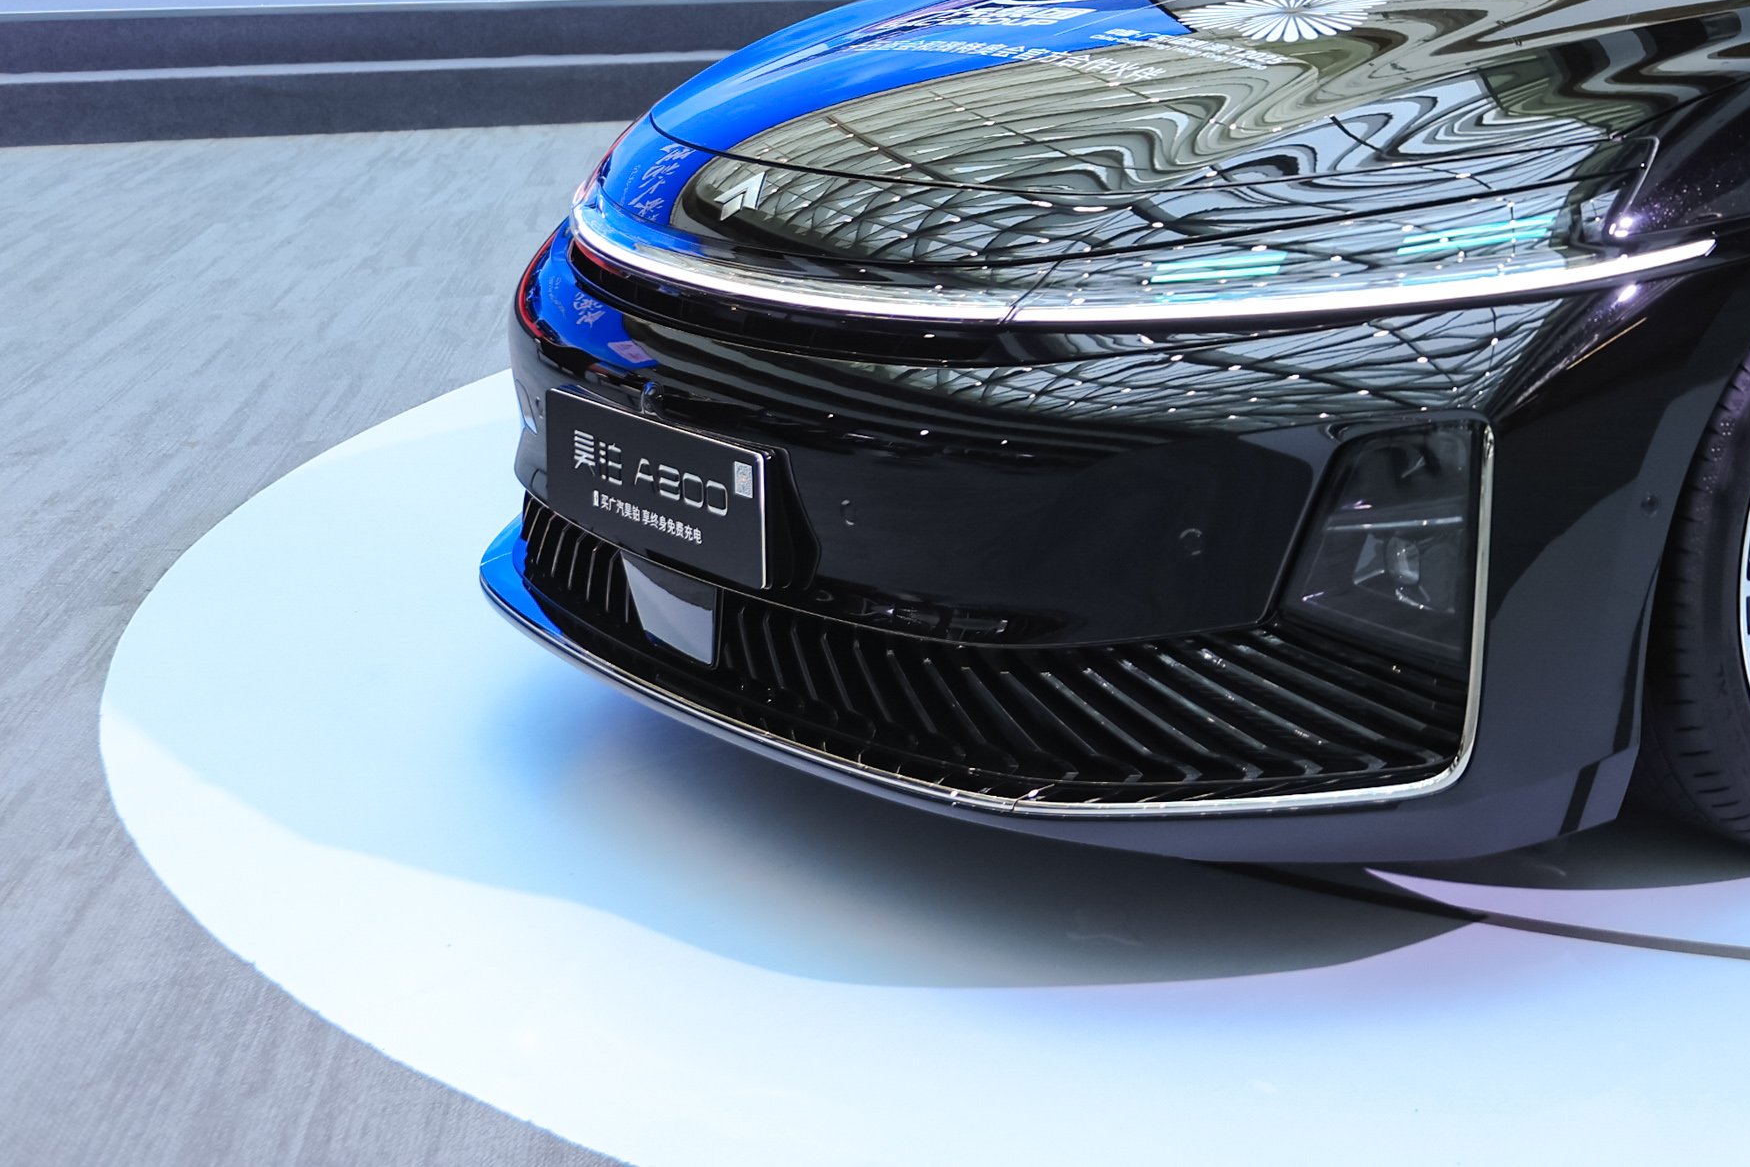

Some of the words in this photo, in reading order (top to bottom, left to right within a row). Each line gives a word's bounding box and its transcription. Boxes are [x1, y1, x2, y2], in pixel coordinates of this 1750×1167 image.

[1235, 49, 1289, 65] 2025
[573, 429, 623, 486] 昊铂
[641, 508, 703, 545] 享终身免费充电
